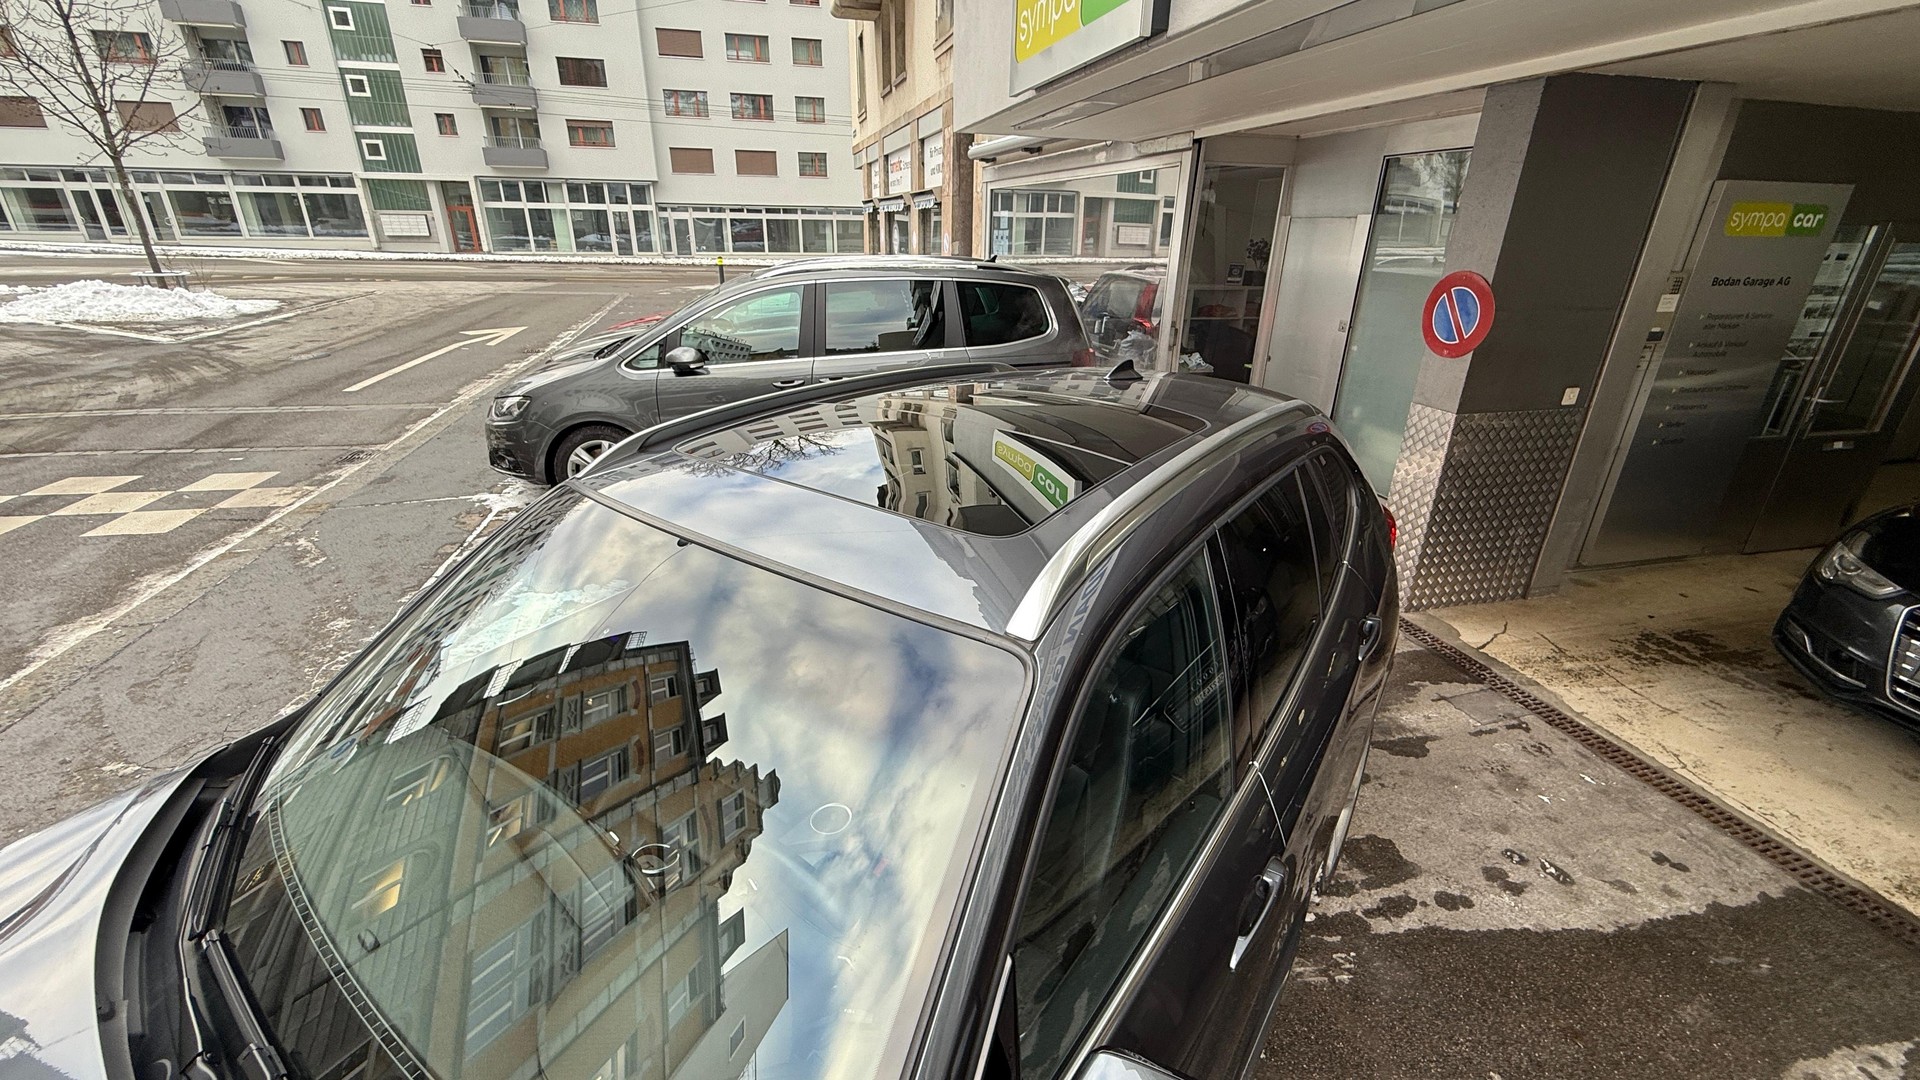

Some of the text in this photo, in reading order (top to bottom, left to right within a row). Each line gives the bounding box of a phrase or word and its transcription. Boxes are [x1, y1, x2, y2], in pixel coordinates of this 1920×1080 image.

[1730, 210, 1824, 231] sympa car
[1711, 276, 1791, 288] Bodan Garage AG
